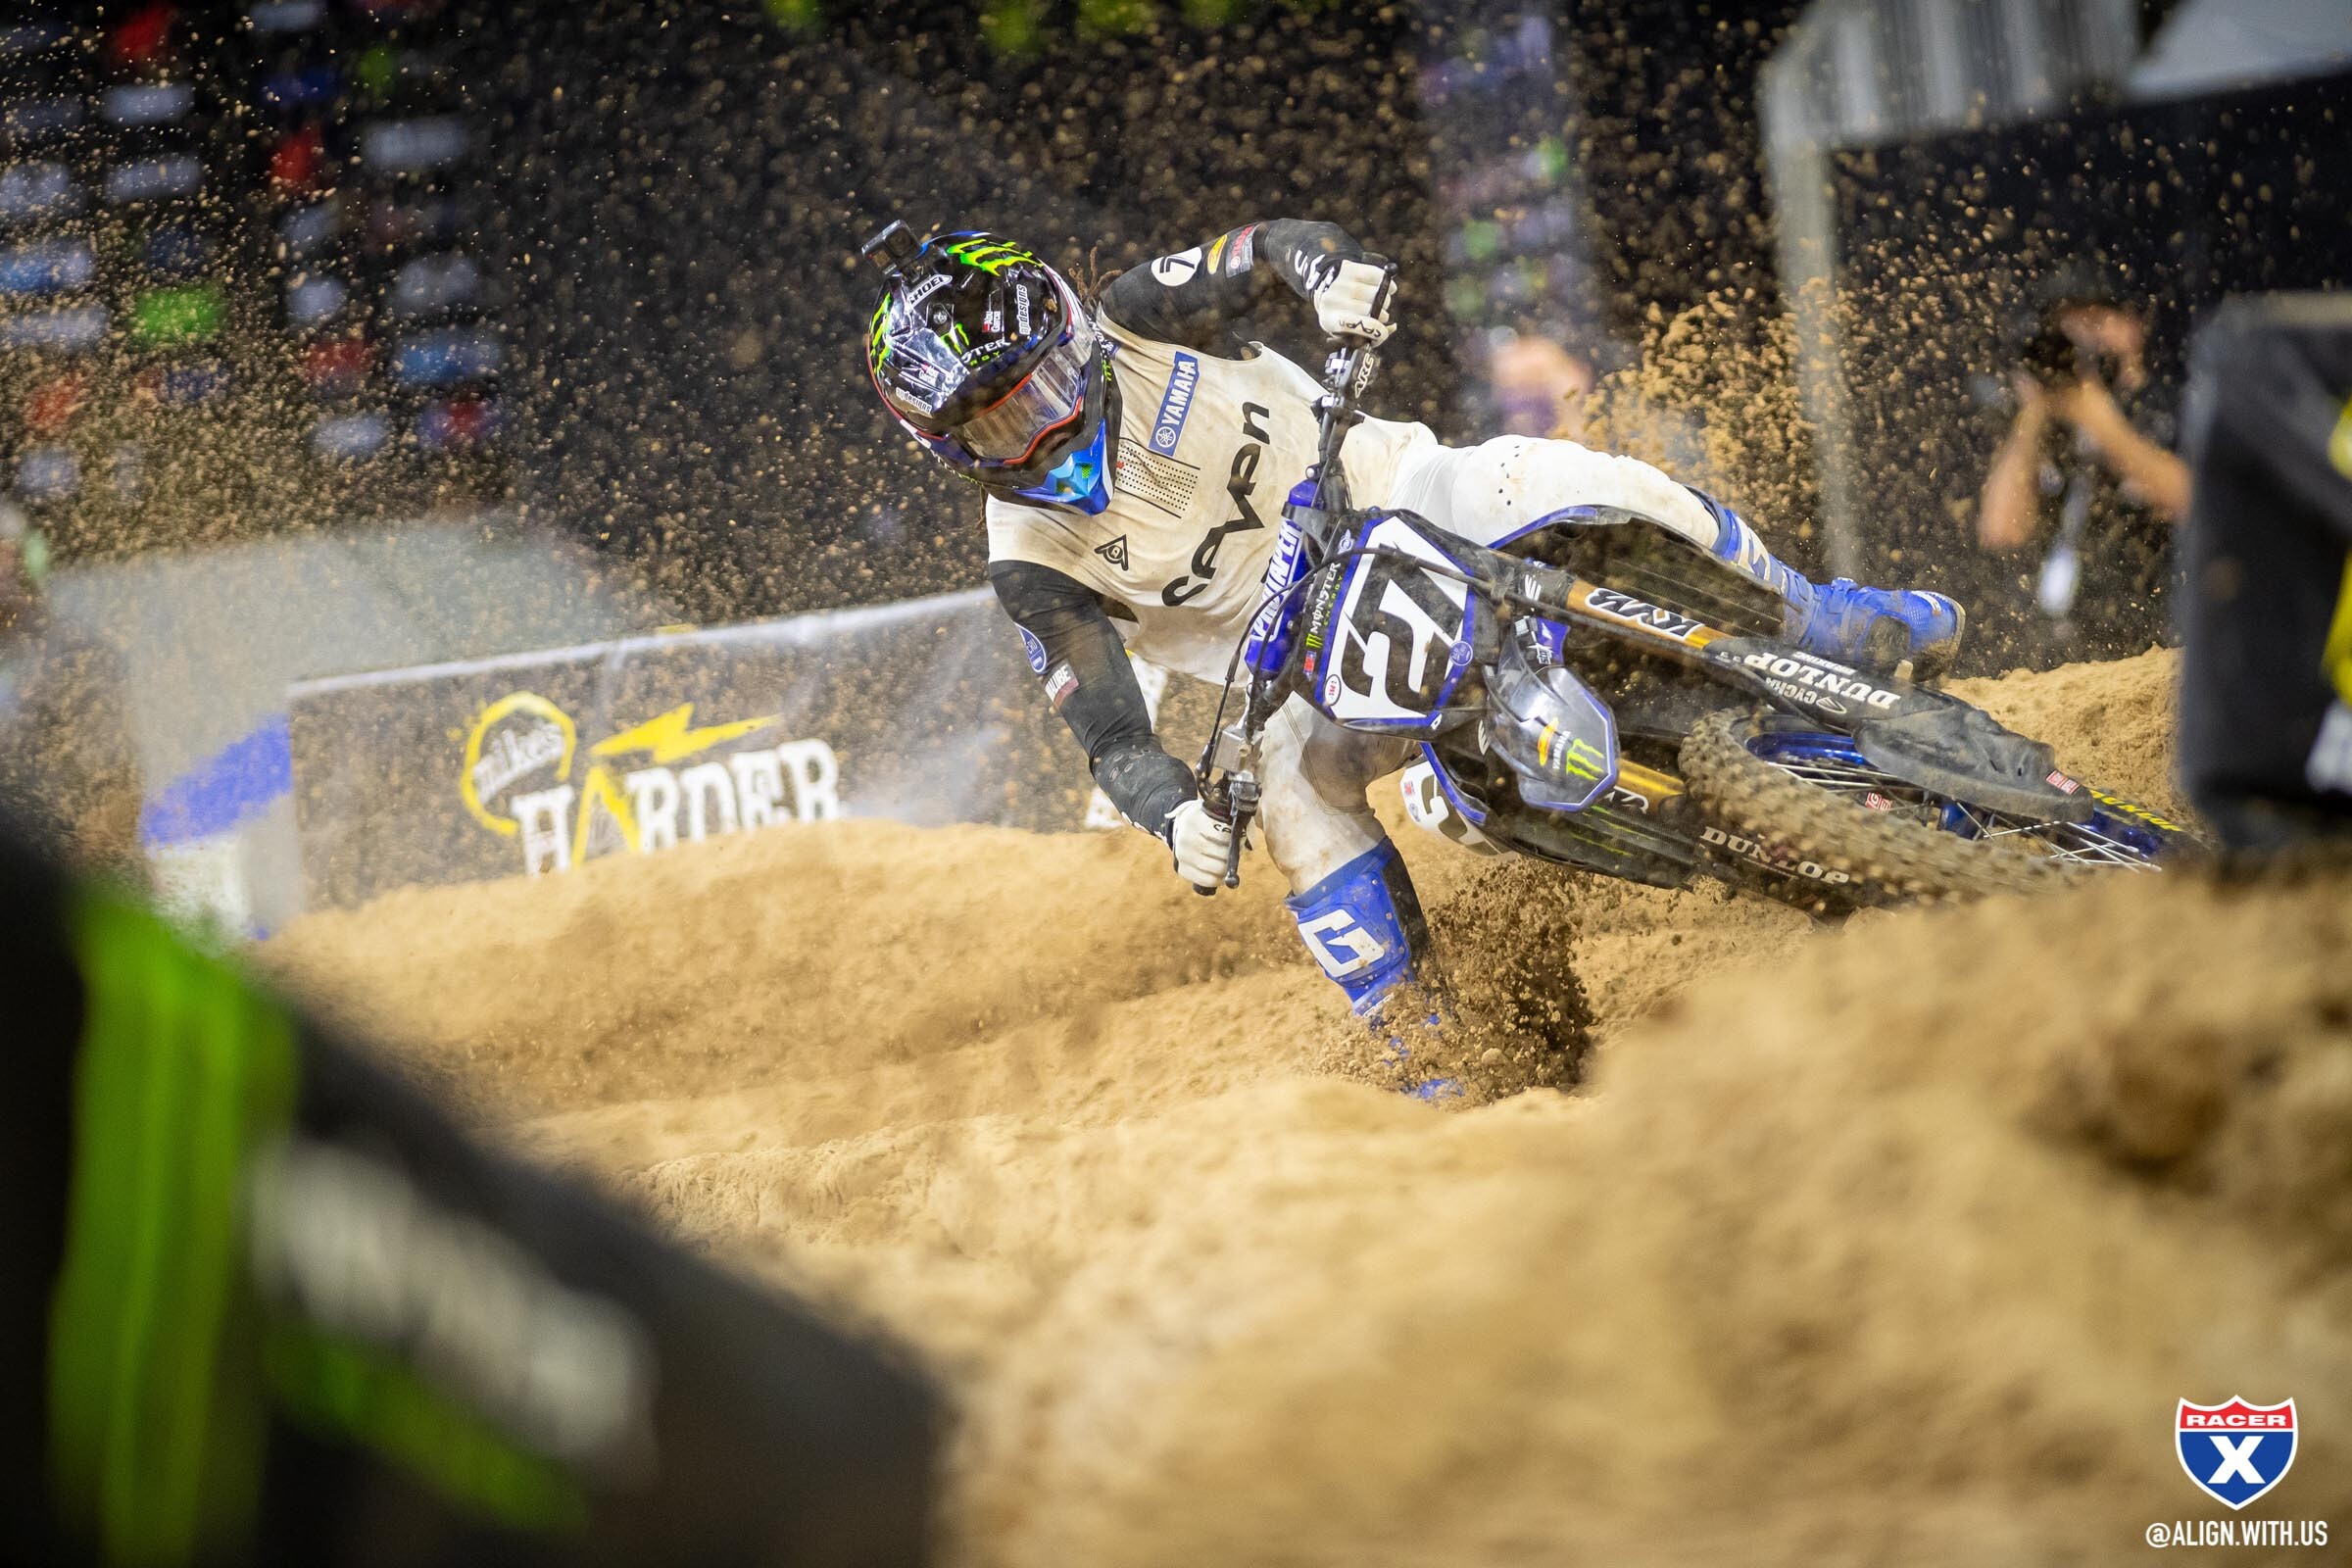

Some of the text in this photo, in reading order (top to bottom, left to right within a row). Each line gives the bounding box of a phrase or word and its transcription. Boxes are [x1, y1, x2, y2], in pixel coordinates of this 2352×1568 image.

[961, 338, 1011, 364] STER
[1355, 353, 1374, 399] ARC
[1160, 360, 1198, 428] YAMAHA
[1309, 561, 1342, 634] MONSTER
[1323, 574, 1344, 627] ENERGY
[1341, 541, 1470, 716] 27
[1742, 652, 1902, 710] DUNLOP
[1551, 729, 1572, 772] YAMAHA
[512, 738, 841, 877] HARDER
[1698, 824, 1851, 885] DUNLOP
